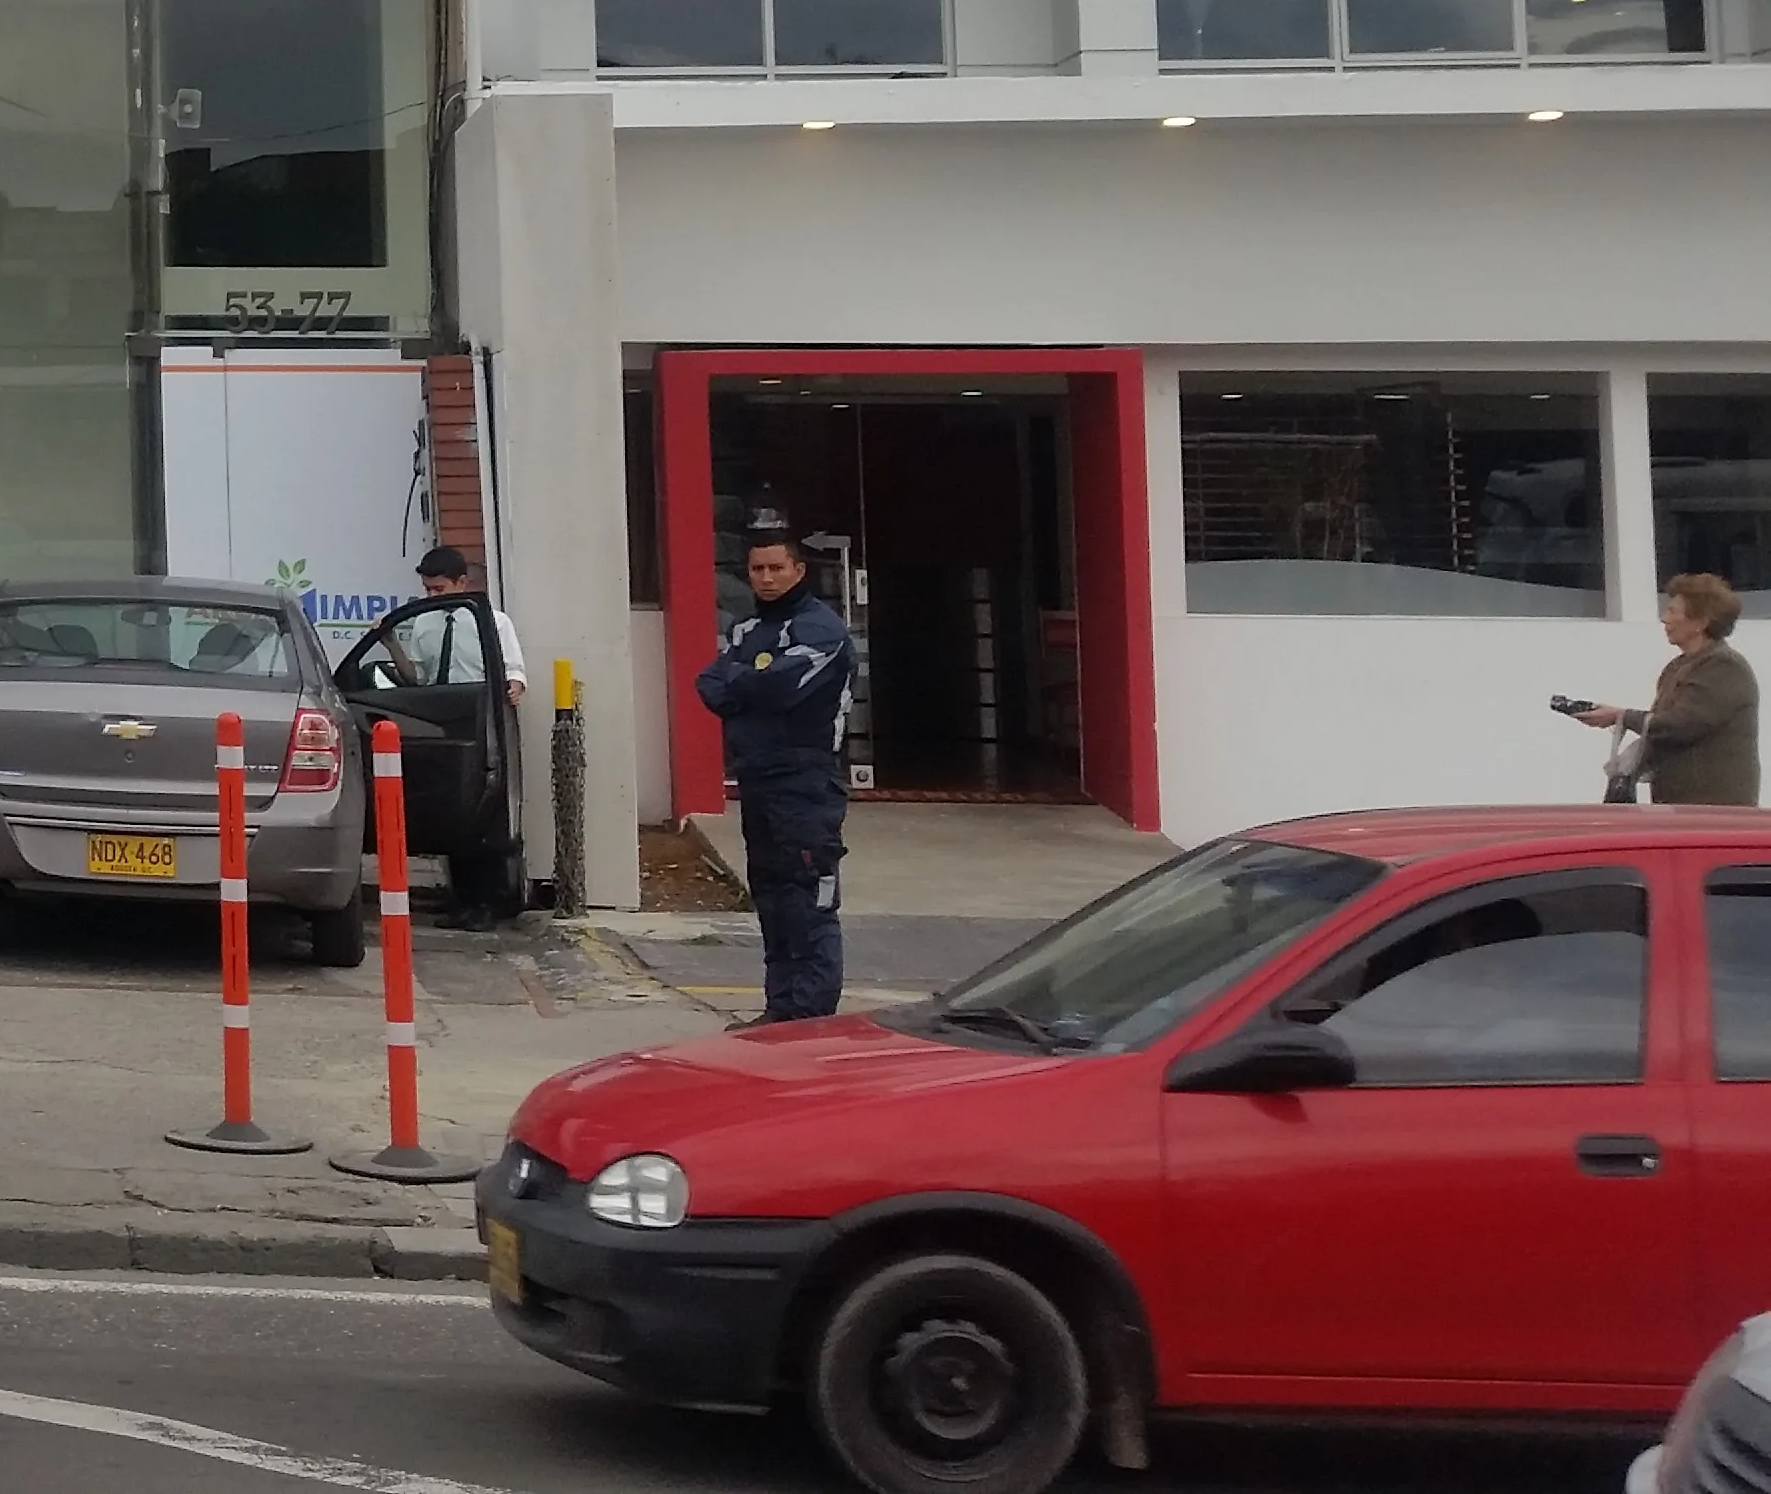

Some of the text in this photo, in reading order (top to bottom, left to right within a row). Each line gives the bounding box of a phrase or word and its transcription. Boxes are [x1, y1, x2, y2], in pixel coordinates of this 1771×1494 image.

[225, 290, 351, 335] 53-77
[320, 594, 423, 620] IMPI
[91, 840, 173, 866] NDX 468
